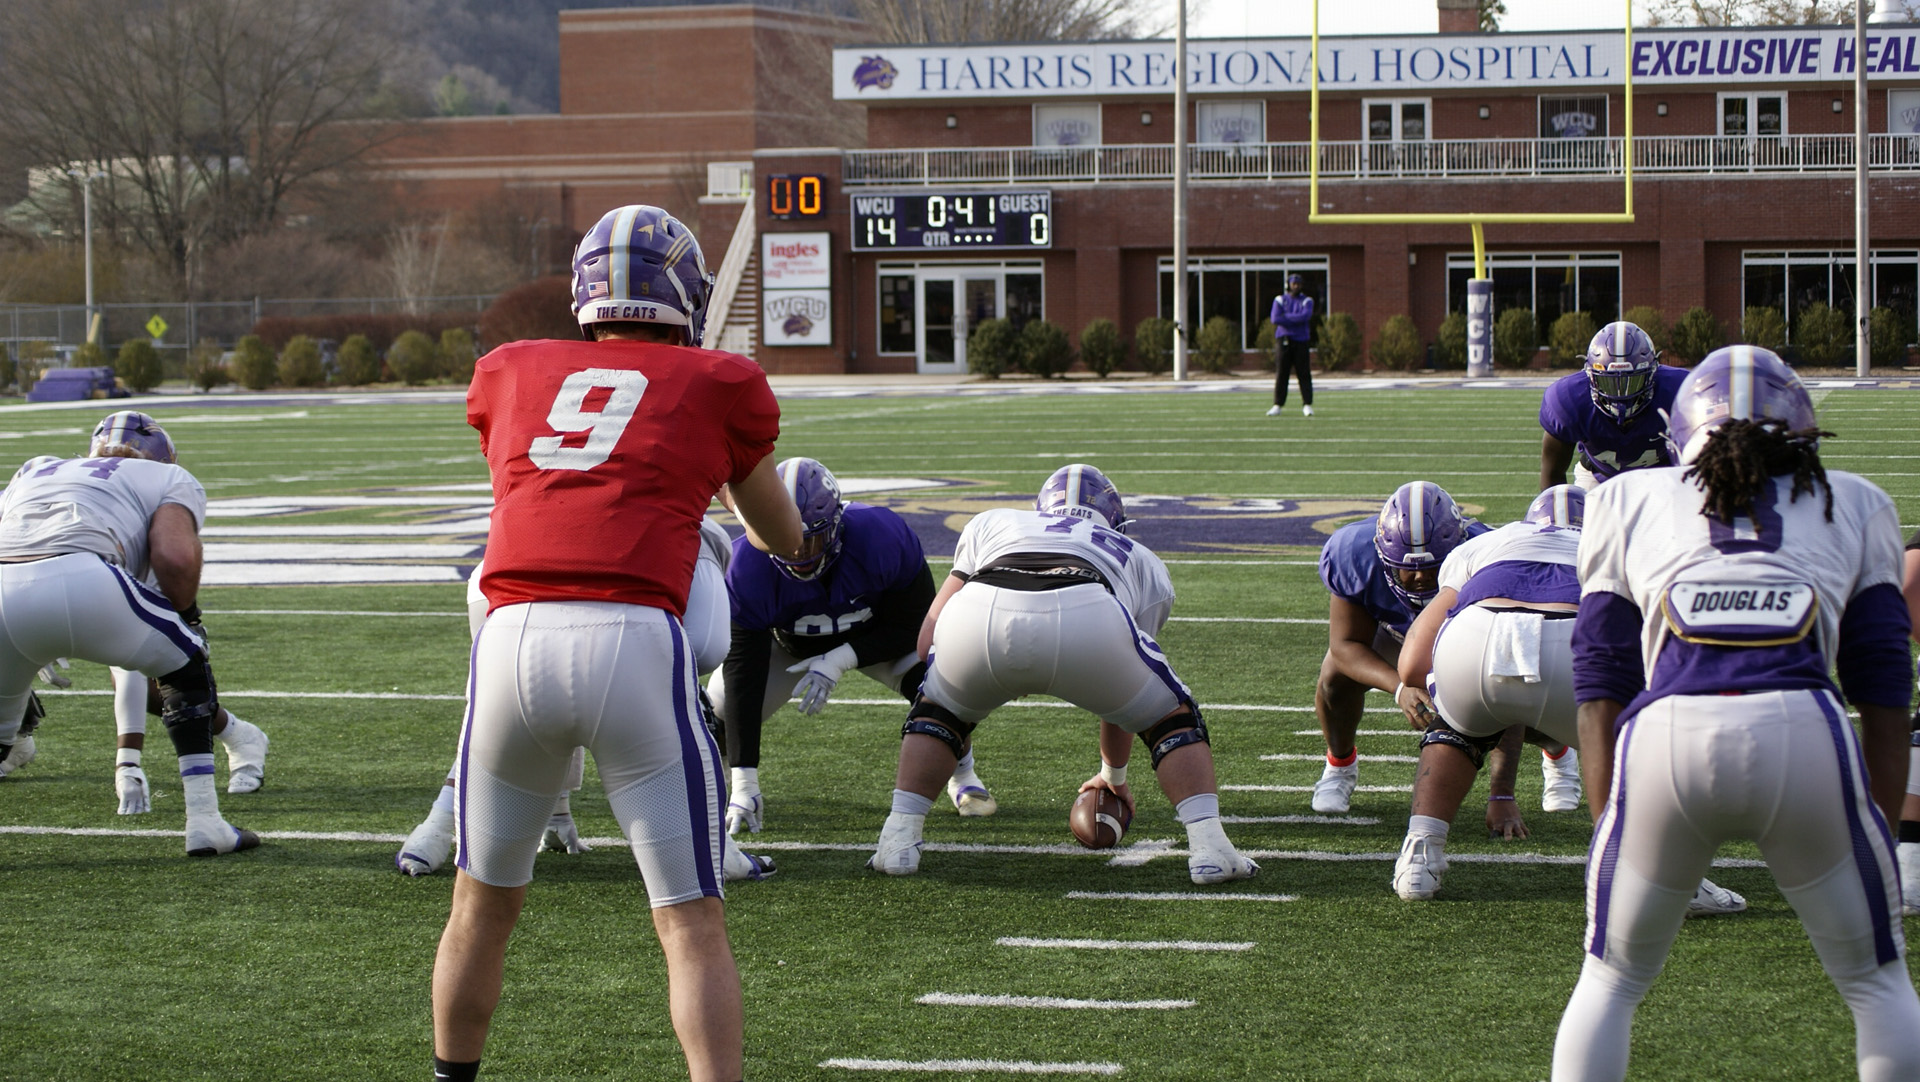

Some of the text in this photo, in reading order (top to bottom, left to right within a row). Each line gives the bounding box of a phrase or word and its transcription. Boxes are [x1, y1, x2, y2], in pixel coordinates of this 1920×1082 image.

[918, 44, 1610, 91] HARRIS REGIONAL HOSPITAL
[1632, 36, 1920, 76] EXCLUSIVE HEAL
[1551, 111, 1597, 131] WCU
[856, 197, 895, 215] WCU
[928, 196, 995, 227] 0:41
[999, 195, 1048, 213] GUEST
[867, 218, 896, 245] 14
[923, 231, 950, 247] QTR
[1030, 213, 1048, 245] 0
[770, 242, 819, 258] ingles
[641, 282, 650, 295] 9
[597, 306, 657, 320] THE CATS
[766, 295, 827, 322] WCU
[1467, 294, 1488, 364] WCU
[528, 368, 649, 471] 9
[1053, 509, 1093, 519] THE CATS
[1038, 512, 1134, 568] 72
[1690, 590, 1792, 613] DOUGLAS
